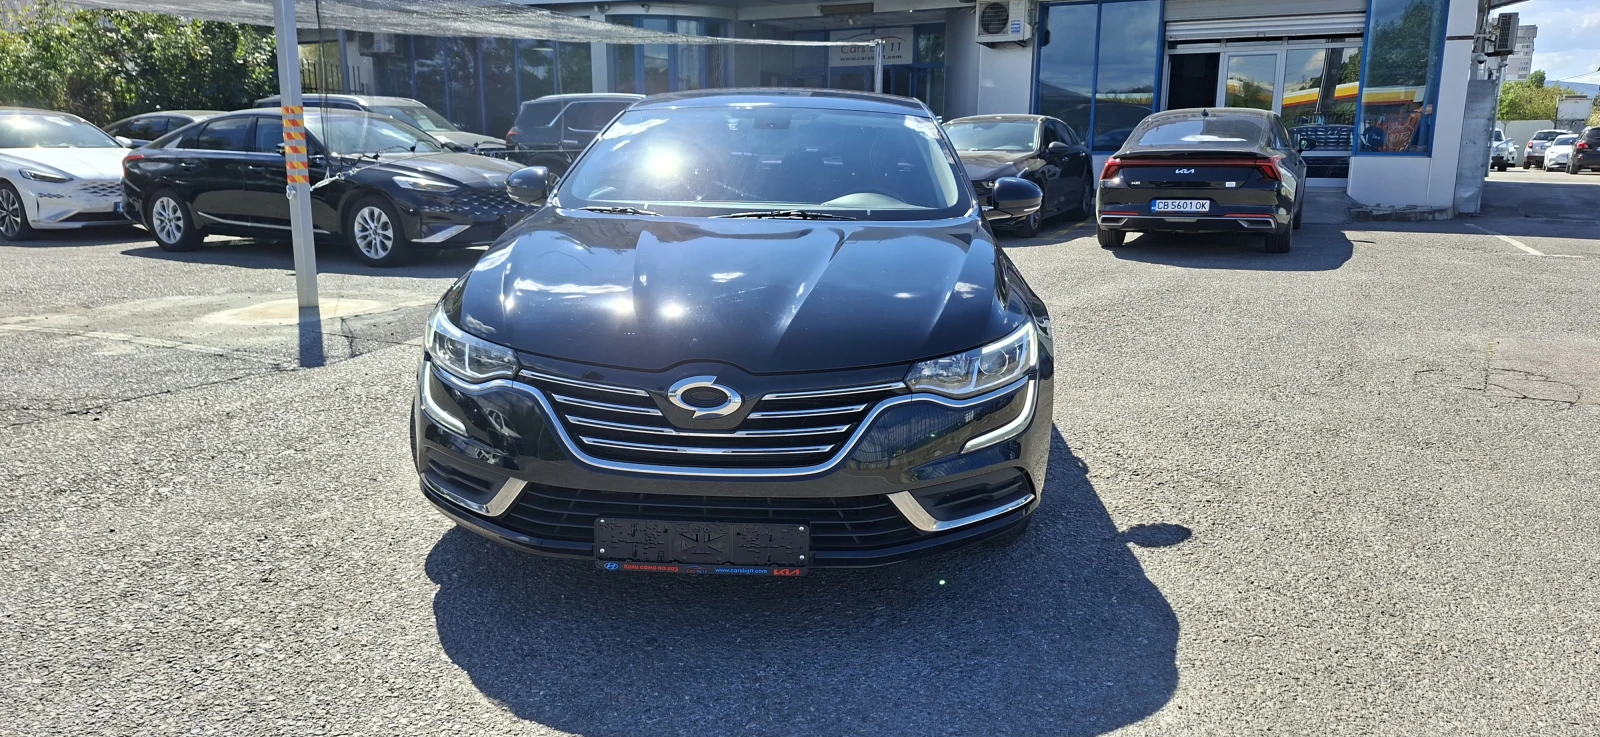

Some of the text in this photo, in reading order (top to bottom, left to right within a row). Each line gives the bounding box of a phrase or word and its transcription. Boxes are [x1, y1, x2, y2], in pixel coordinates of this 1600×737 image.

[840, 45, 866, 54] Cars
[890, 42, 902, 52] 11
[1157, 201, 1169, 210] CB
[1171, 201, 1193, 210] 5601
[1195, 202, 1207, 210] OK
